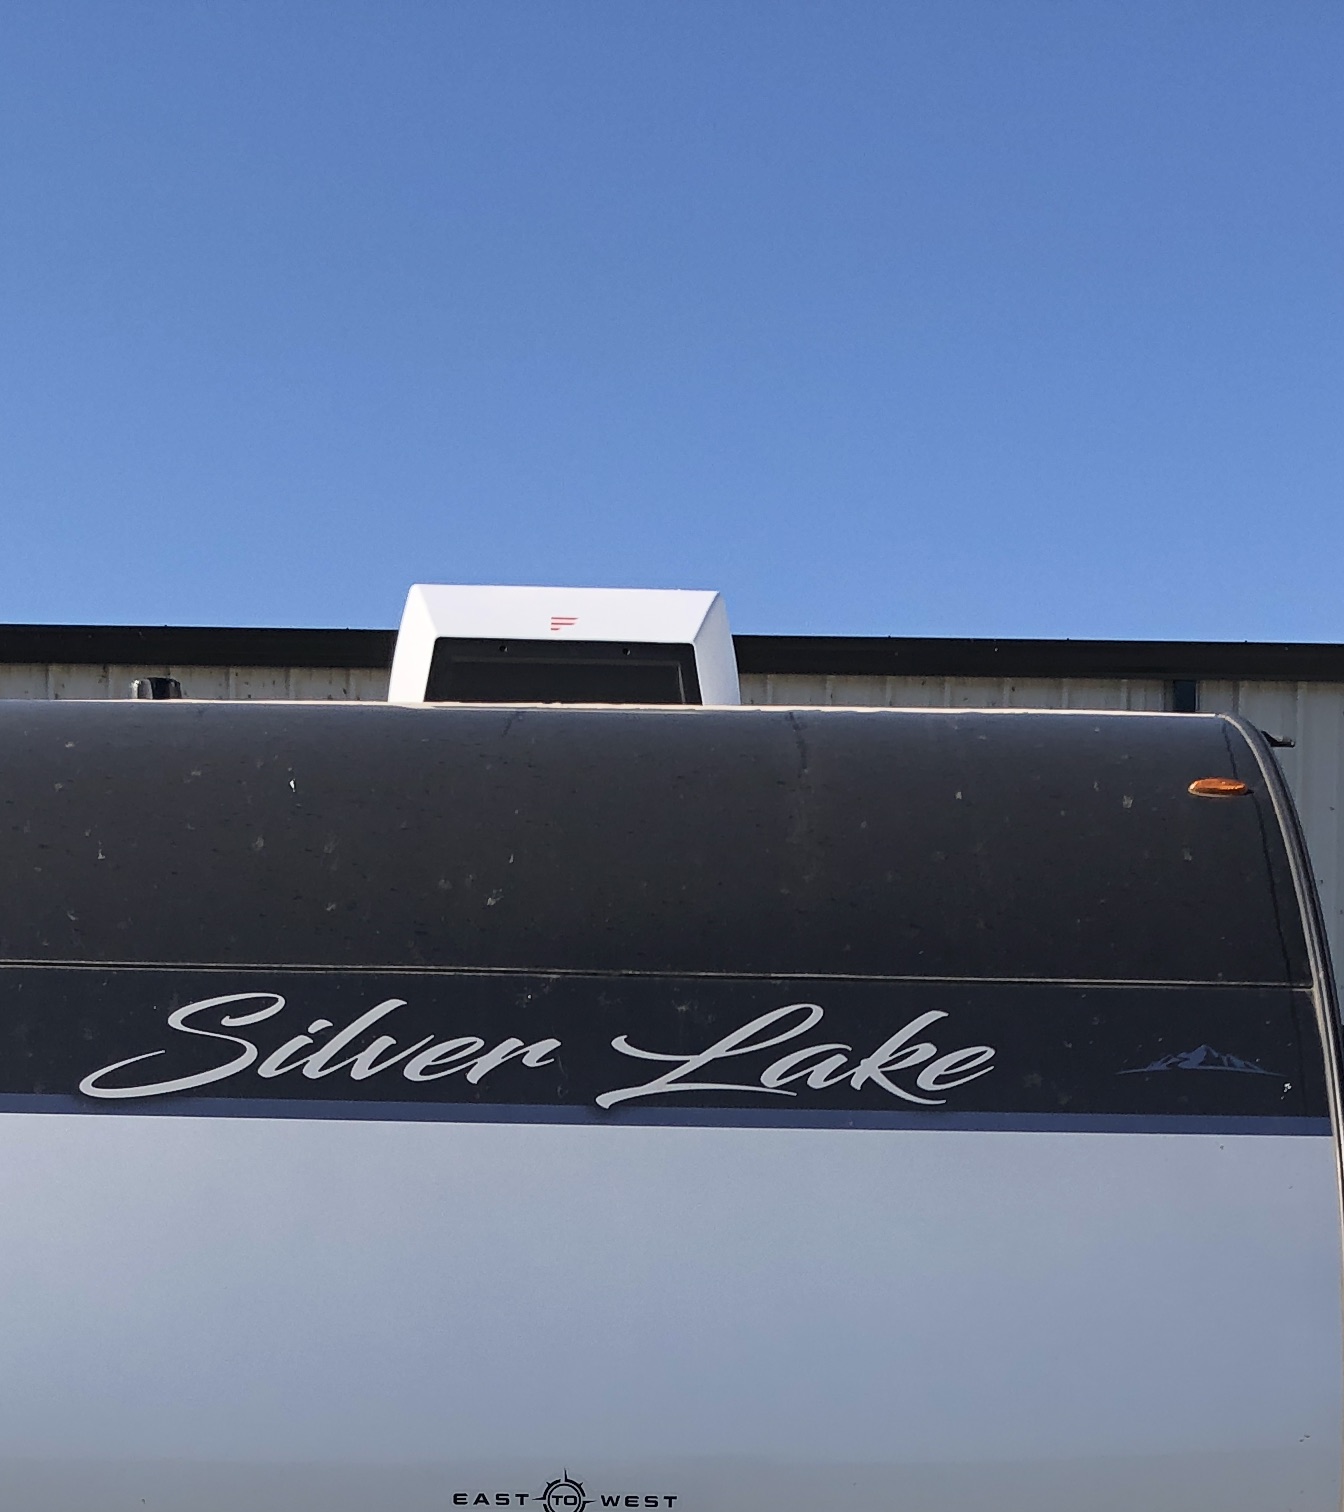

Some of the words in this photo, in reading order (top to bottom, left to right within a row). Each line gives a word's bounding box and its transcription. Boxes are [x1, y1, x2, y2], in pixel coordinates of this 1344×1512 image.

[80, 992, 560, 1100] Silver
[595, 1003, 995, 1110] Lake
[452, 1492, 530, 1506] EAST
[552, 1494, 578, 1506] TO
[600, 1494, 678, 1508] WEST
